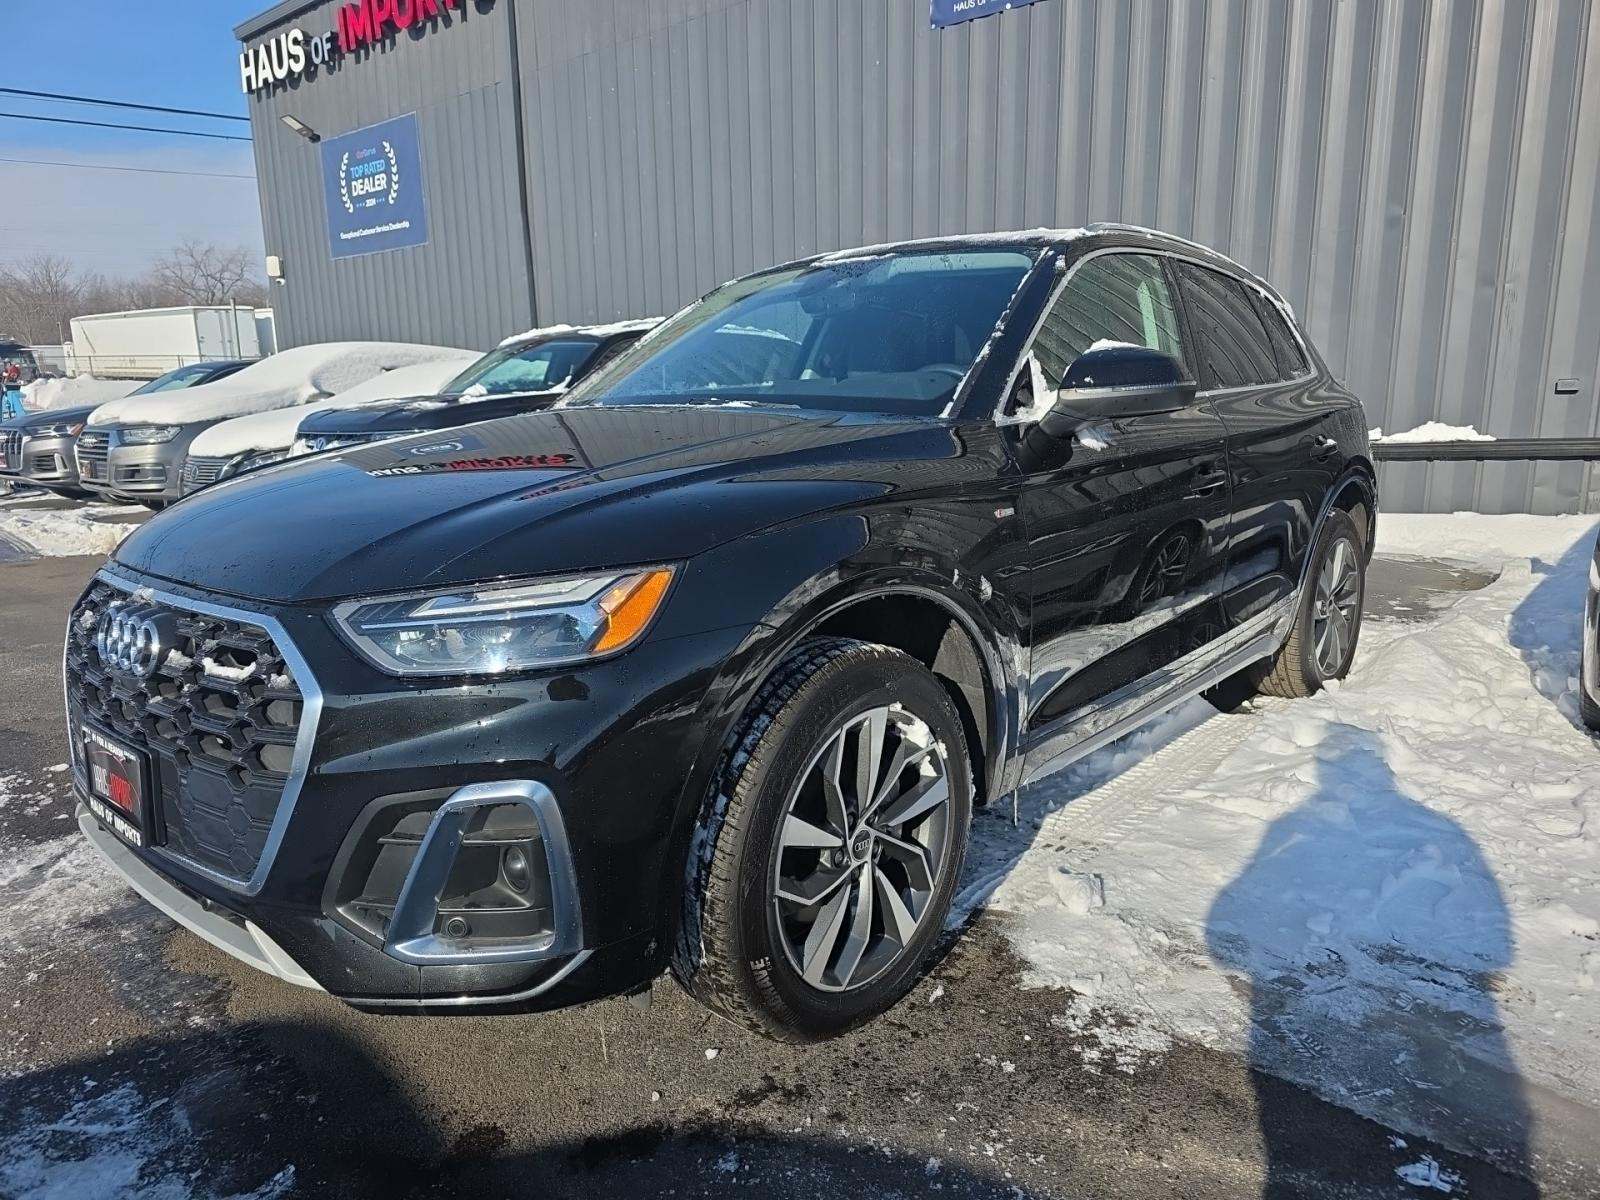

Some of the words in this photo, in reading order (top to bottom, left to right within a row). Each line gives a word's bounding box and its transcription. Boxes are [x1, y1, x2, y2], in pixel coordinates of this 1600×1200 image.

[239, 28, 306, 94] HAUS
[311, 30, 332, 65] OF
[350, 163, 364, 179] TOP
[365, 159, 385, 175] RATED
[352, 174, 386, 196] DEALER
[113, 814, 141, 846] IMPORTS
